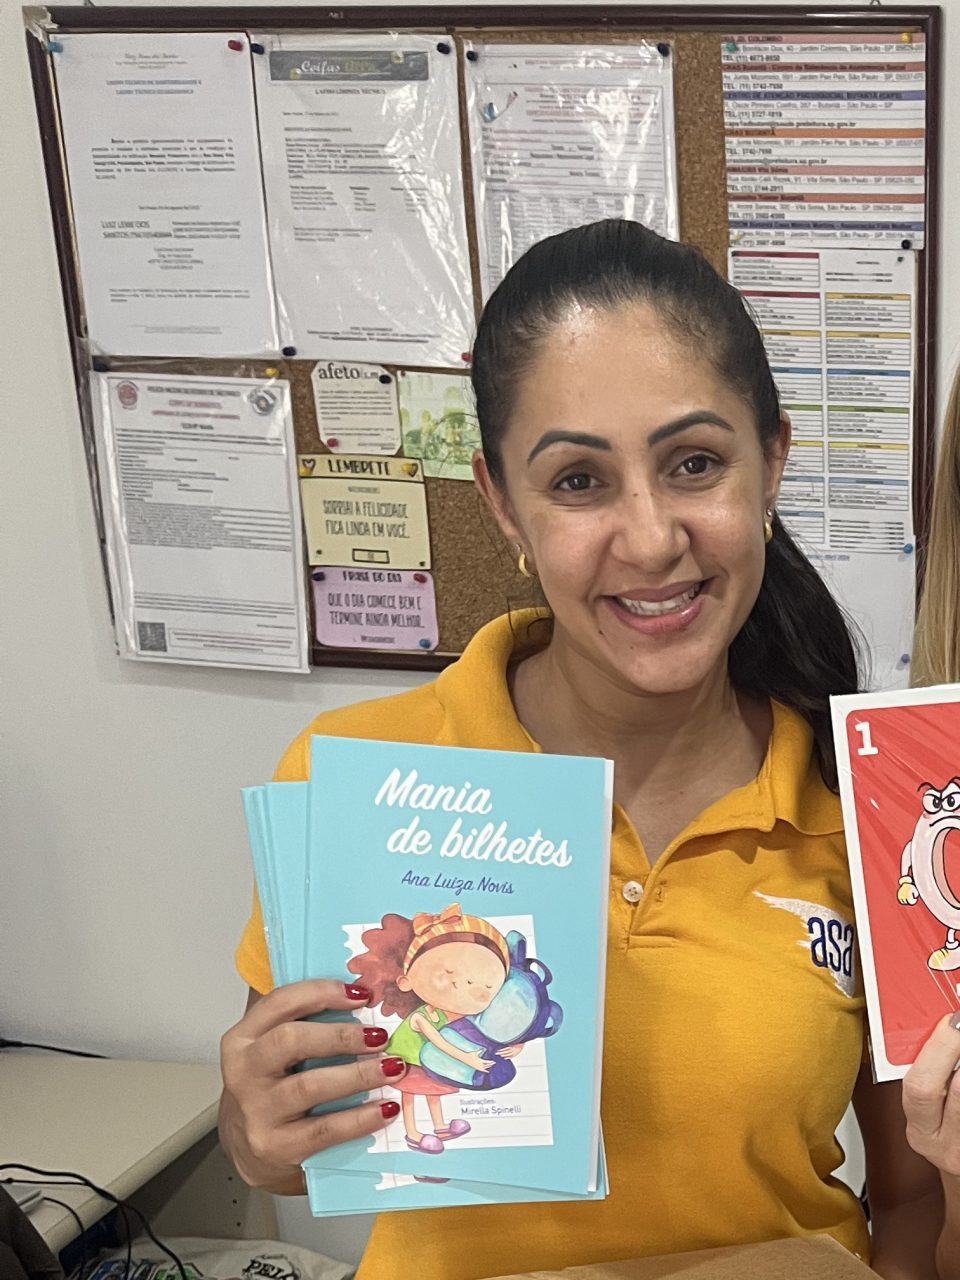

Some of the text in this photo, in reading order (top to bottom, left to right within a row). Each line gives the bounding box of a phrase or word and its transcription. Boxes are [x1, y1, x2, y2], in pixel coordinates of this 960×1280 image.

[318, 362, 360, 380] afeto
[328, 459, 390, 476] LEMBRETE
[854, 720, 879, 756] 1
[374, 768, 493, 815] Mania
[386, 815, 573, 868] de bilhetes
[401, 870, 514, 897] Ana Luiza Novis
[461, 1105, 522, 1116] Mirella Spinelli
